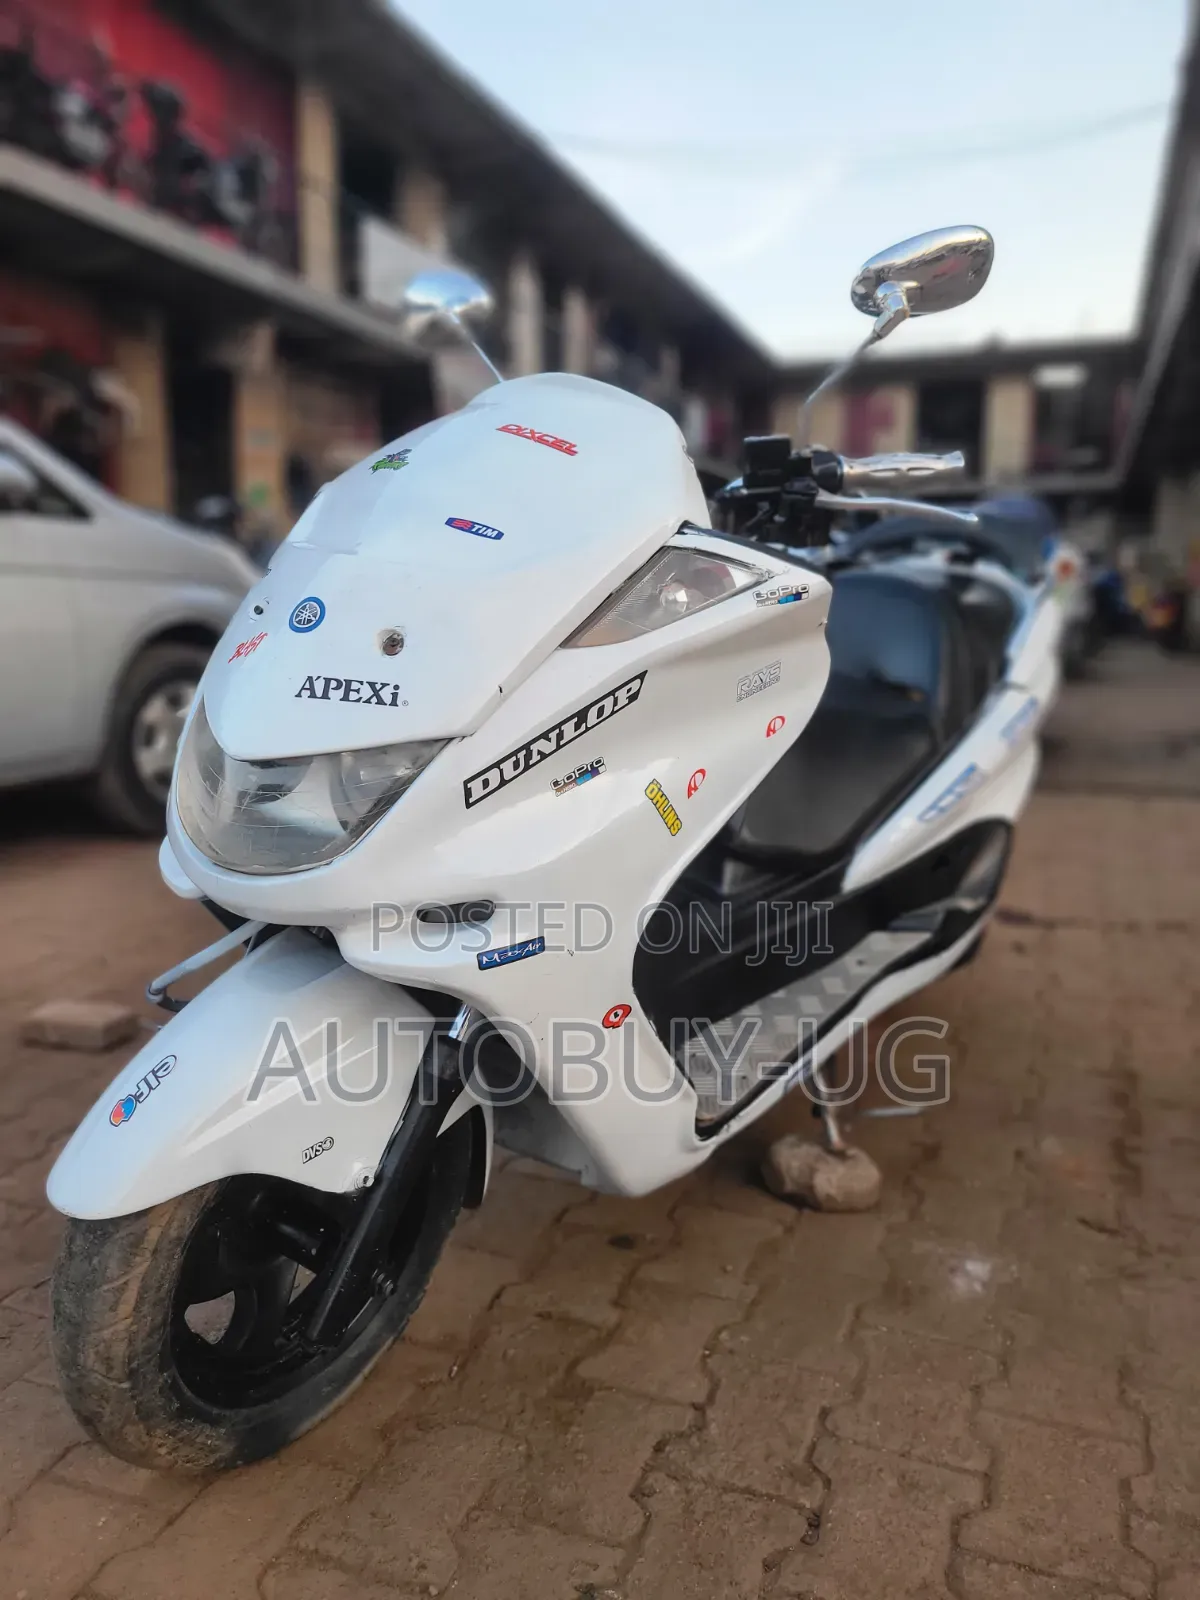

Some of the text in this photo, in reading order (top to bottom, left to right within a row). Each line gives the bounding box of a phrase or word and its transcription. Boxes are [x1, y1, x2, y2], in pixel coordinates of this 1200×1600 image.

[471, 524, 499, 538] TIM
[752, 584, 809, 601] GoPro
[737, 661, 781, 696] RAYS
[466, 678, 643, 804] DUNLOP
[549, 756, 605, 790] GoPro
[302, 1141, 324, 1164] DVS
